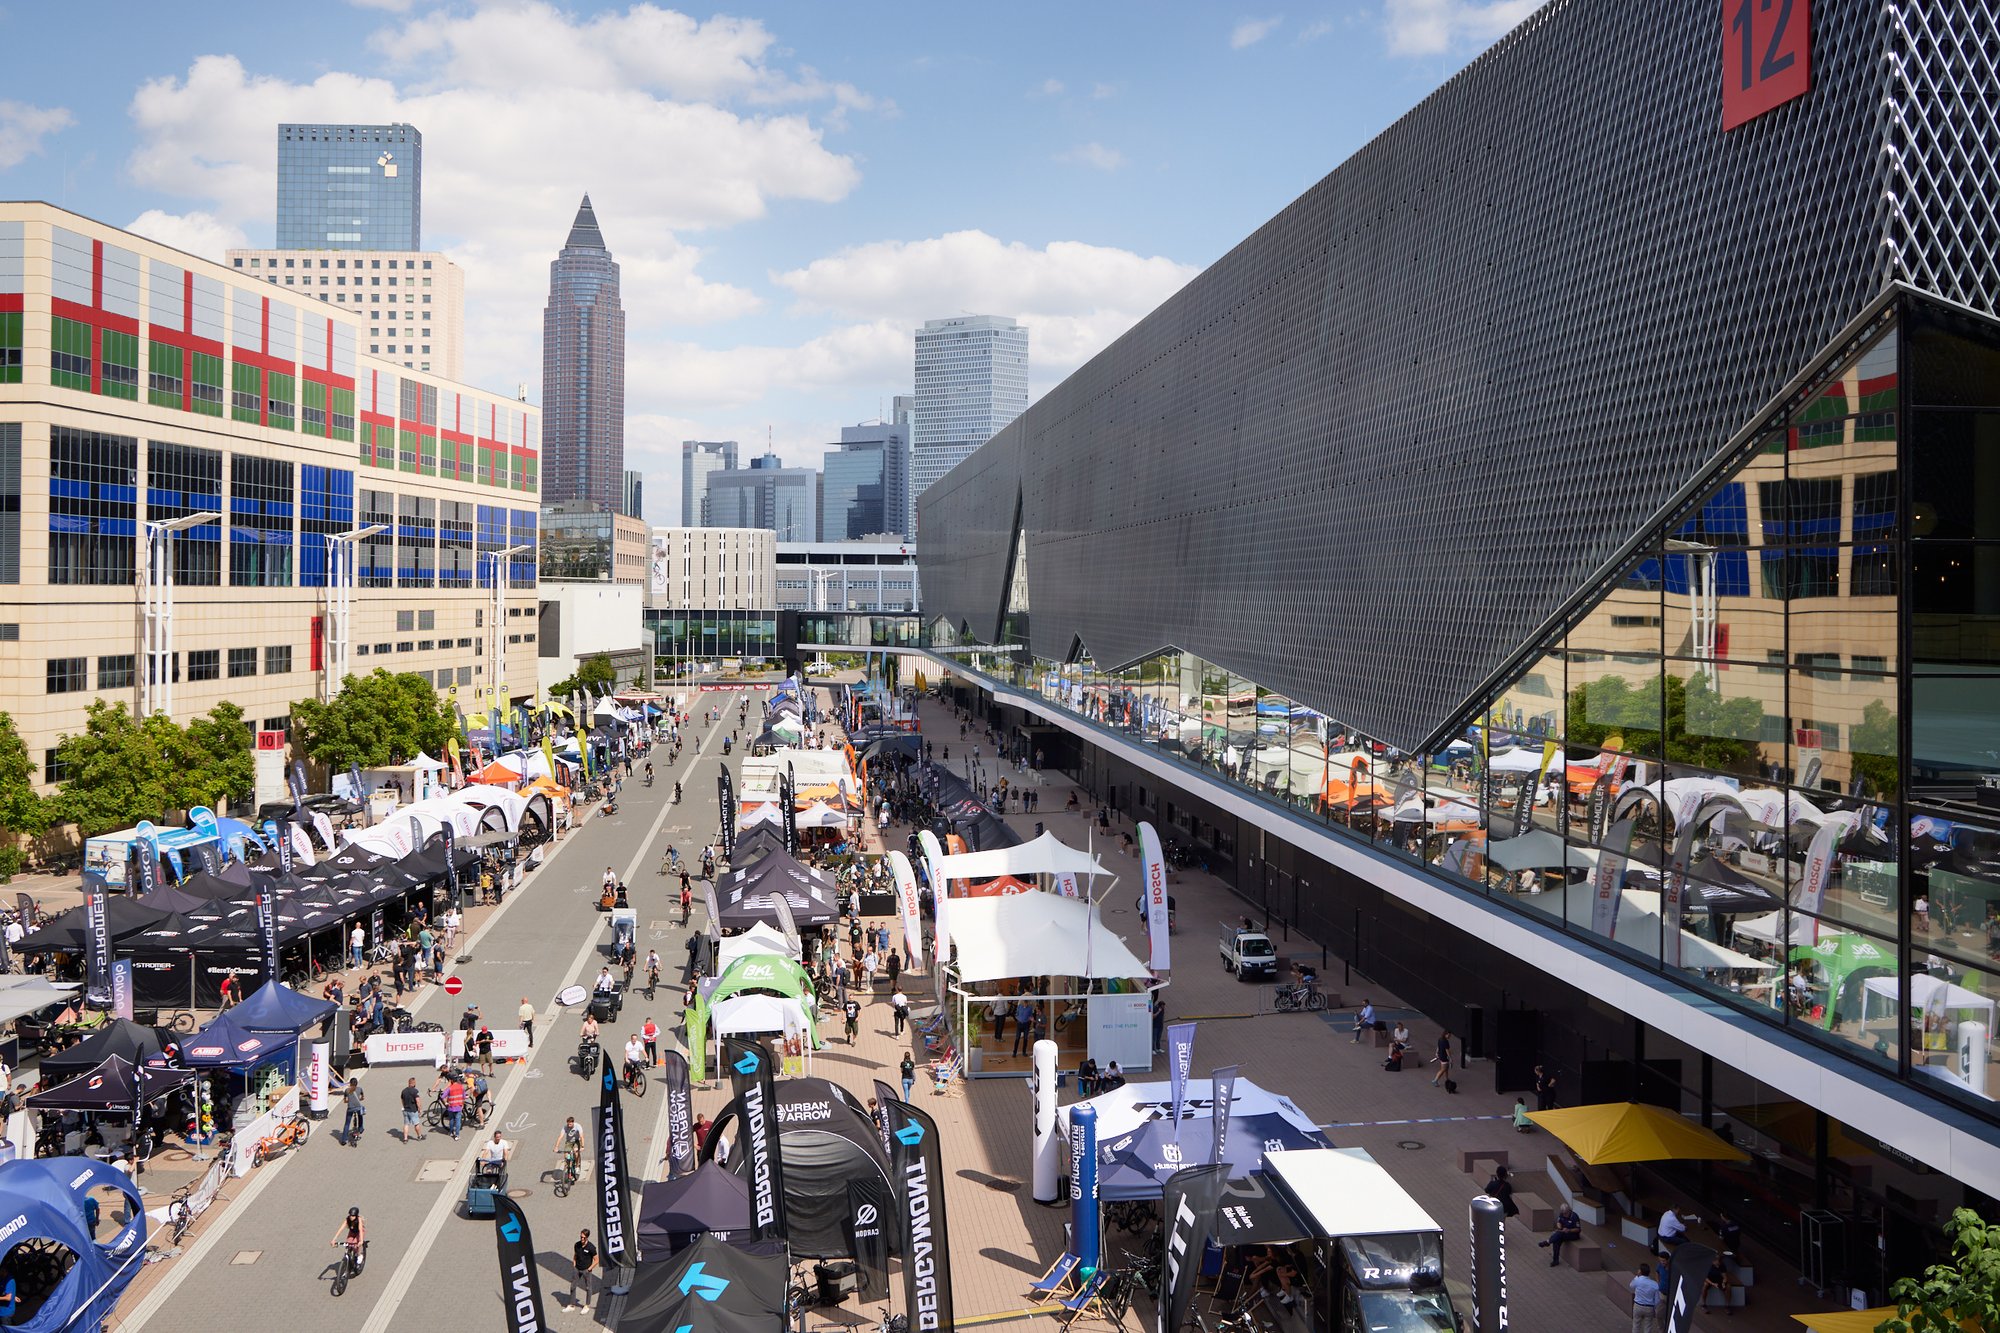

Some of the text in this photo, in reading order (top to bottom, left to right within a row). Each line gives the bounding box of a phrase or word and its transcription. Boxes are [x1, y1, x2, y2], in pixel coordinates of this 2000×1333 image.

[1733, 0, 1794, 91] 12
[261, 735, 273, 747] 10
[1600, 858, 1617, 899] BOSCH
[1808, 858, 1823, 893] BOSCH
[207, 967, 258, 975] #HereToChange
[743, 964, 774, 976] BKL
[386, 1042, 424, 1052] brose
[785, 1102, 829, 1112] URBAN
[786, 1109, 831, 1122] ARROW
[1071, 1124, 1081, 1186] Husqvarna
[70, 1169, 94, 1190] SHIMANO
[0, 1214, 28, 1243] MANO
[1498, 1221, 1509, 1299] RAYMON
